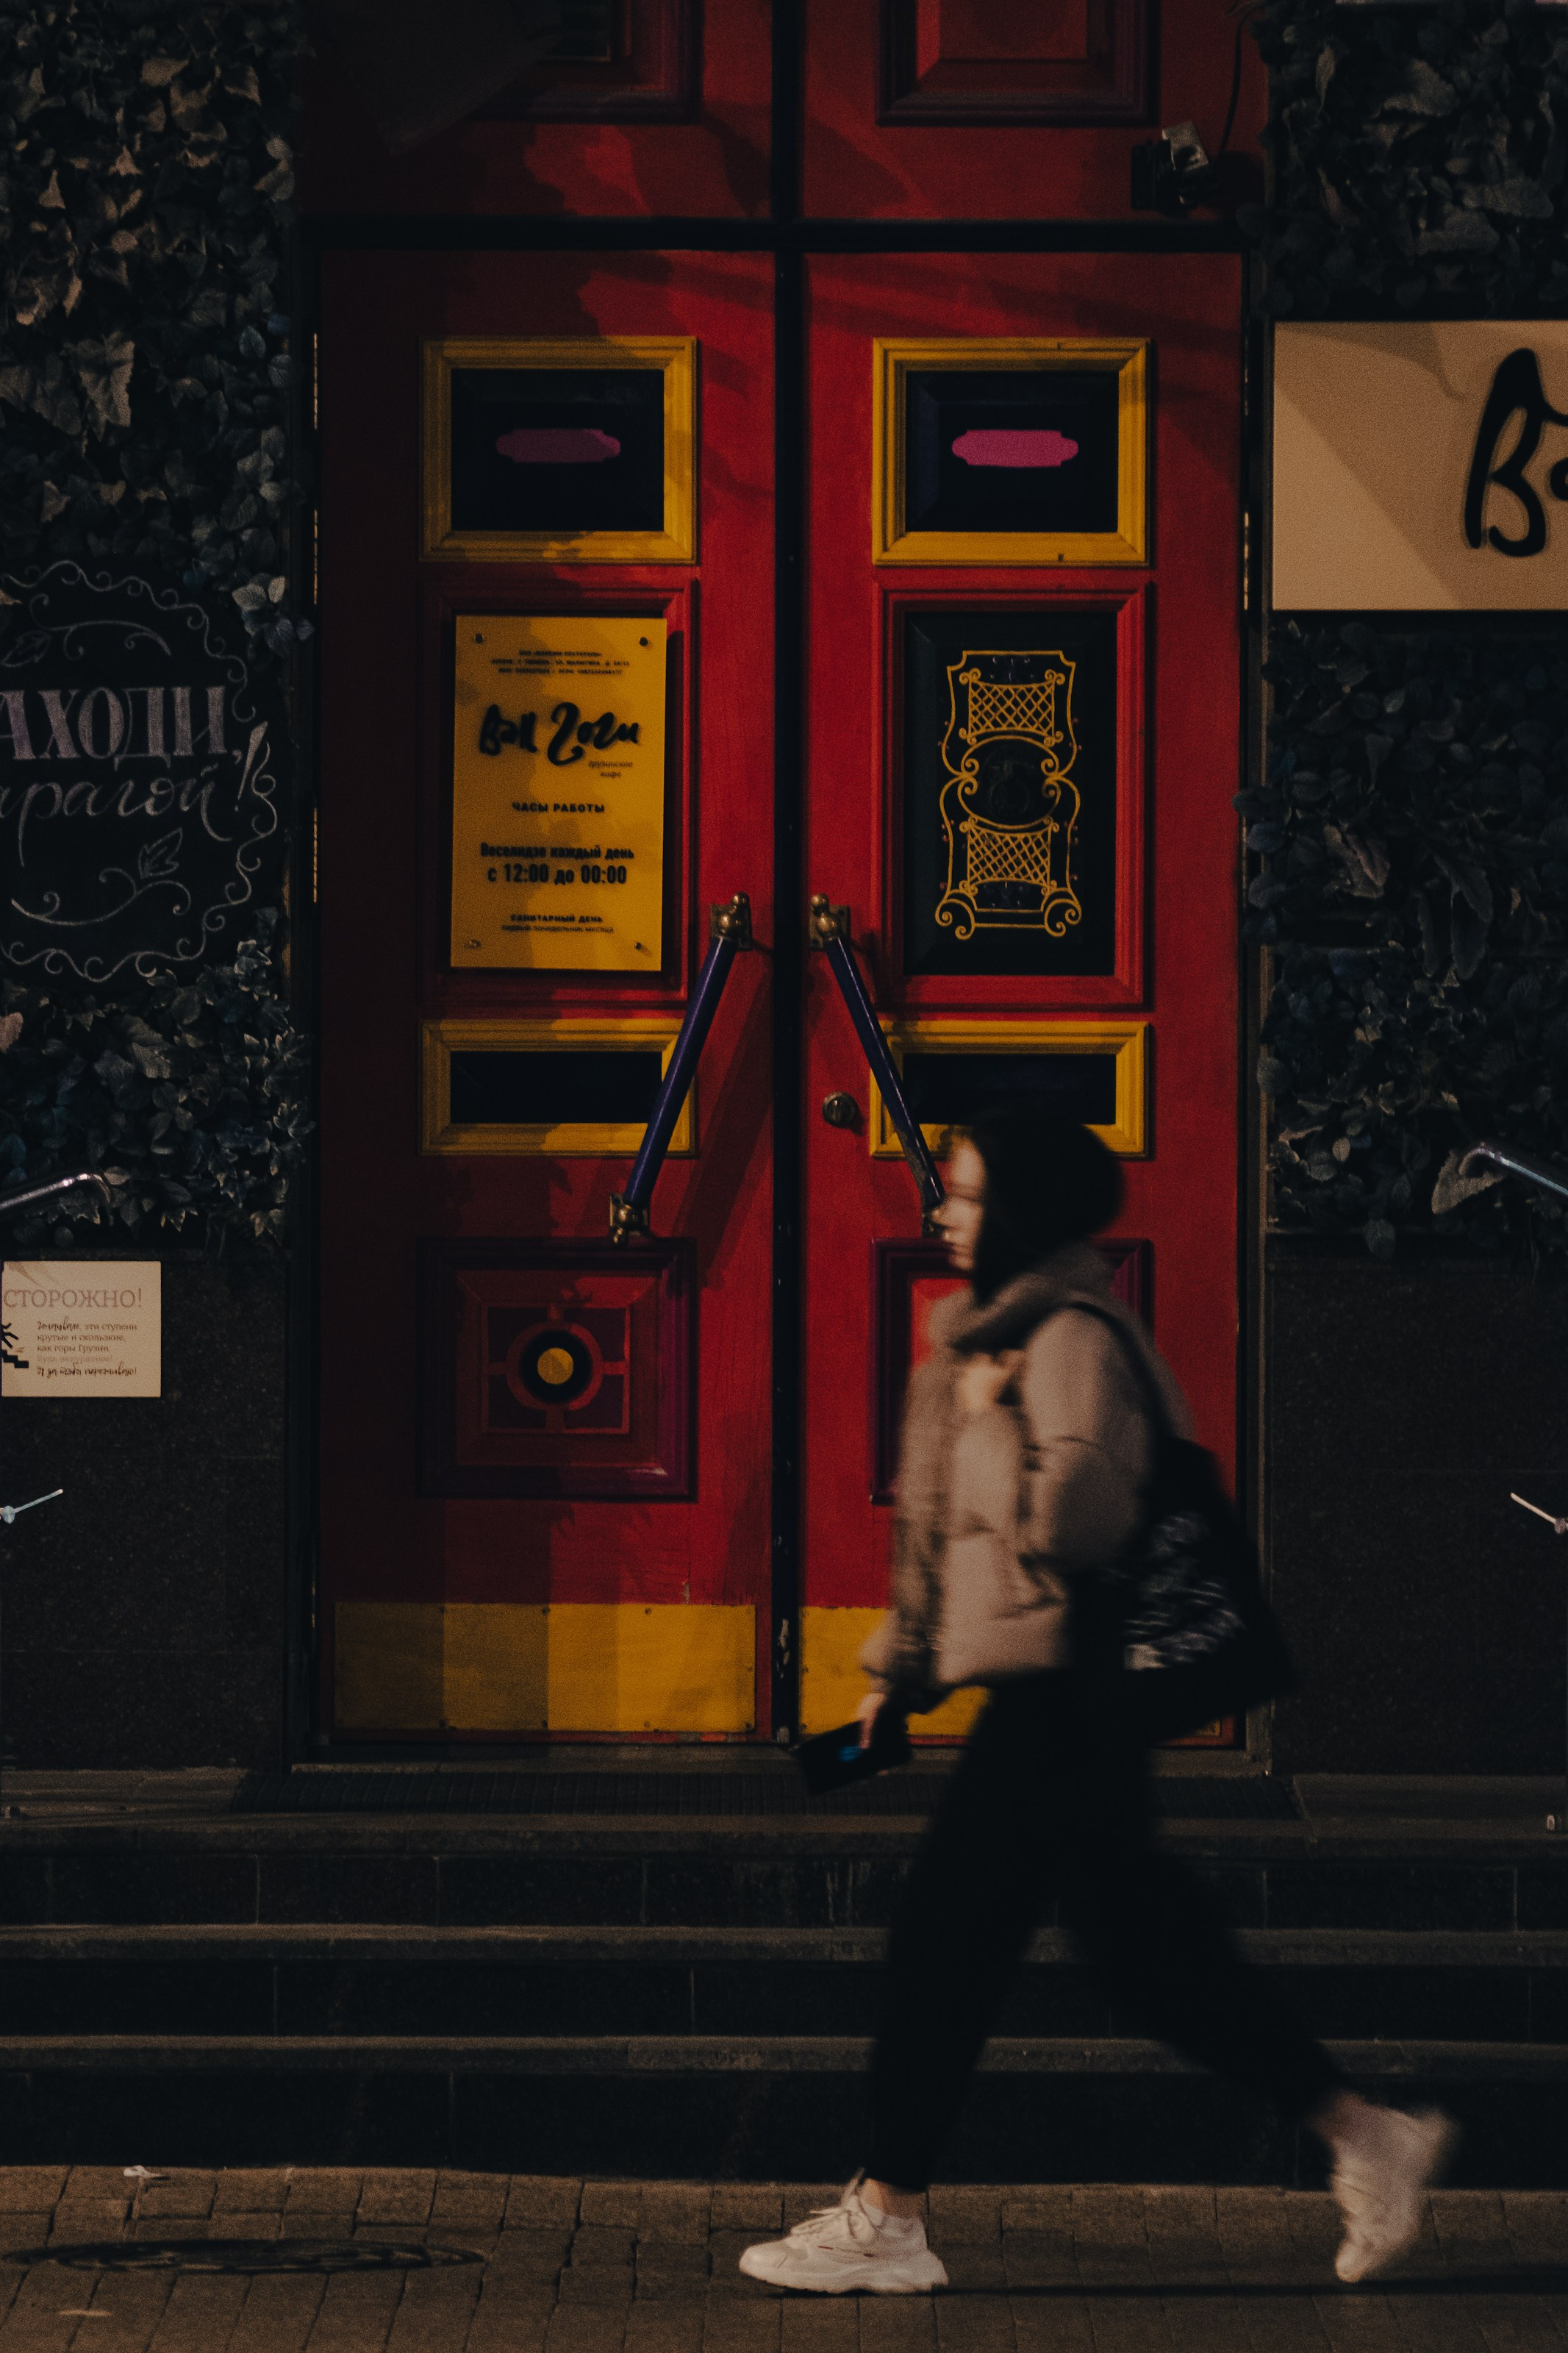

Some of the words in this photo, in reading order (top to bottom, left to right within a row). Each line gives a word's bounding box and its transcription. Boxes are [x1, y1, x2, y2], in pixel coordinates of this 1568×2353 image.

[512, 802, 548, 813] ЧАСЫ
[553, 804, 604, 813] РАБОТЫ
[551, 845, 601, 860] каждый
[605, 848, 634, 860] день
[487, 868, 497, 882] с
[503, 863, 549, 883] 12:00
[554, 869, 575, 885] до
[581, 865, 627, 884] 00:00
[510, 913, 575, 923] САНИТАРНЫЙ
[579, 915, 603, 924] ДЕНЬ
[3, 1288, 142, 1308] СТОРОЖНО!
[101, 1324, 137, 1332] ступени
[37, 1335, 69, 1343] крутые
[54, 1345, 76, 1353] горы
